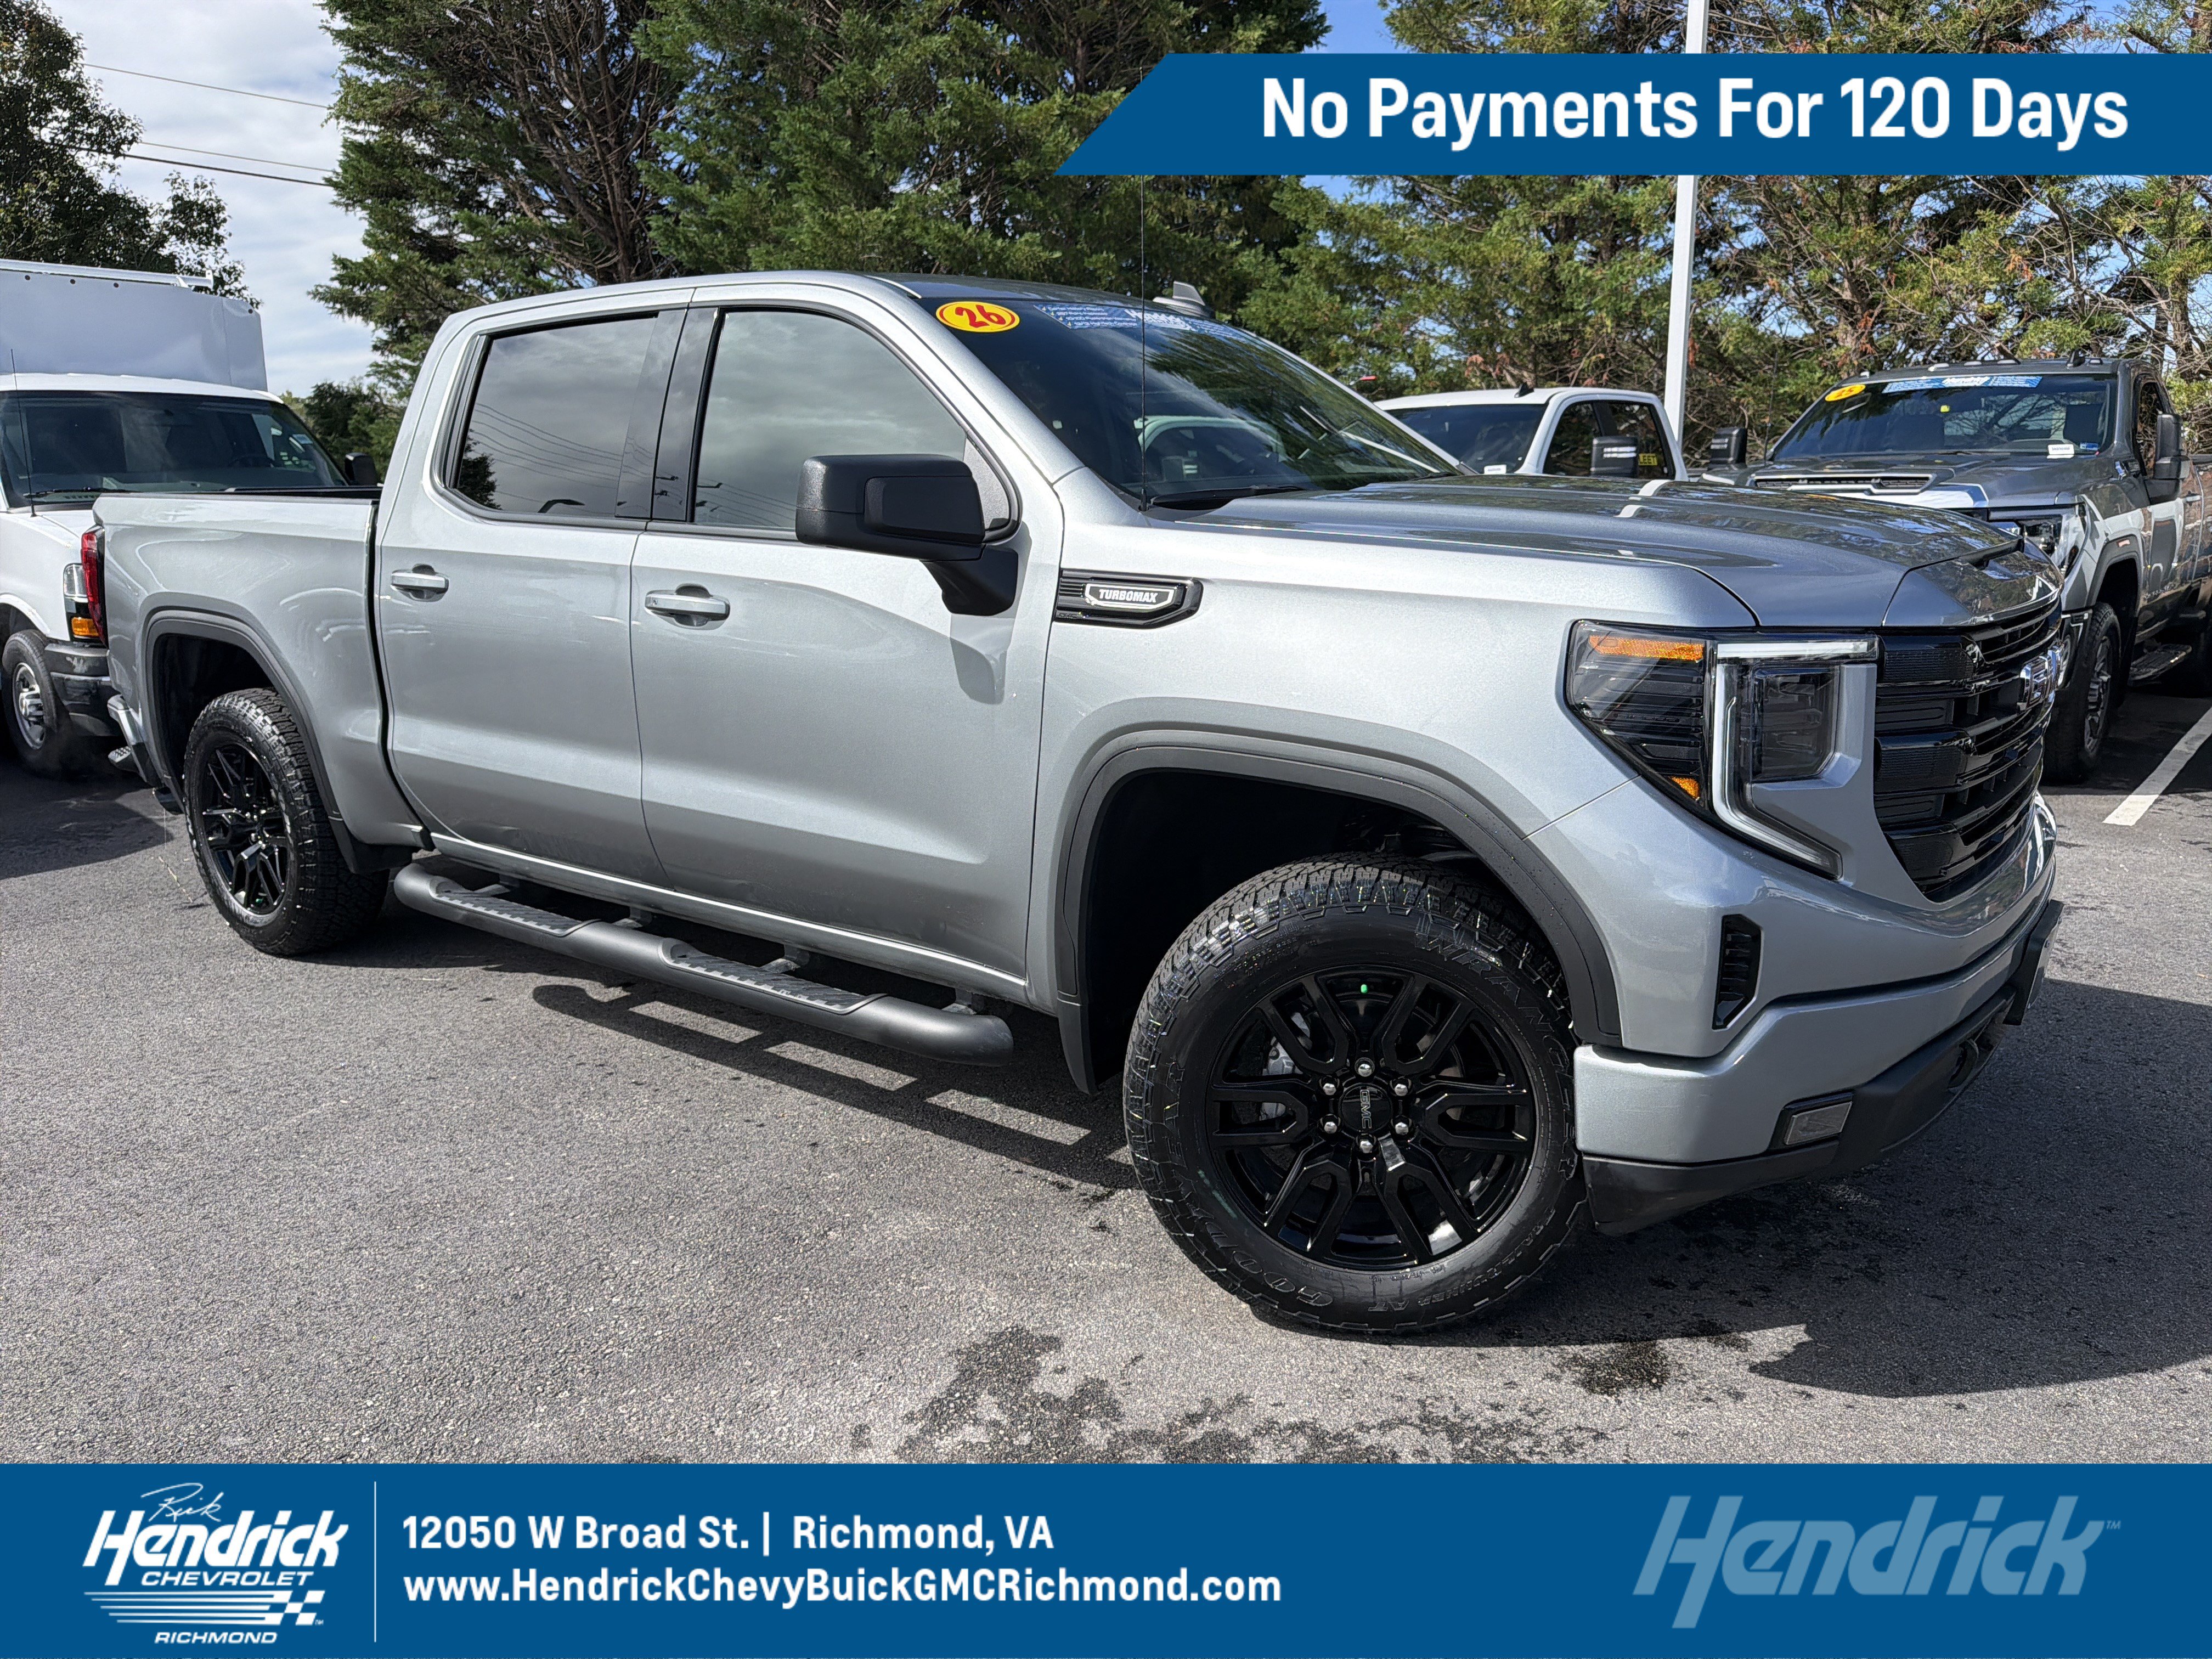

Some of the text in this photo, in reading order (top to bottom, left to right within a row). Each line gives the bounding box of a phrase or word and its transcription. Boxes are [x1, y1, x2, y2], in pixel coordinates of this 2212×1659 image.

[955, 304, 1006, 328] 26
[1639, 455, 1657, 464] LEET
[1098, 589, 1158, 603] TURBOMAX
[1360, 1089, 1372, 1129] GMC
[1163, 1063, 1334, 1307] GOODYEAR
